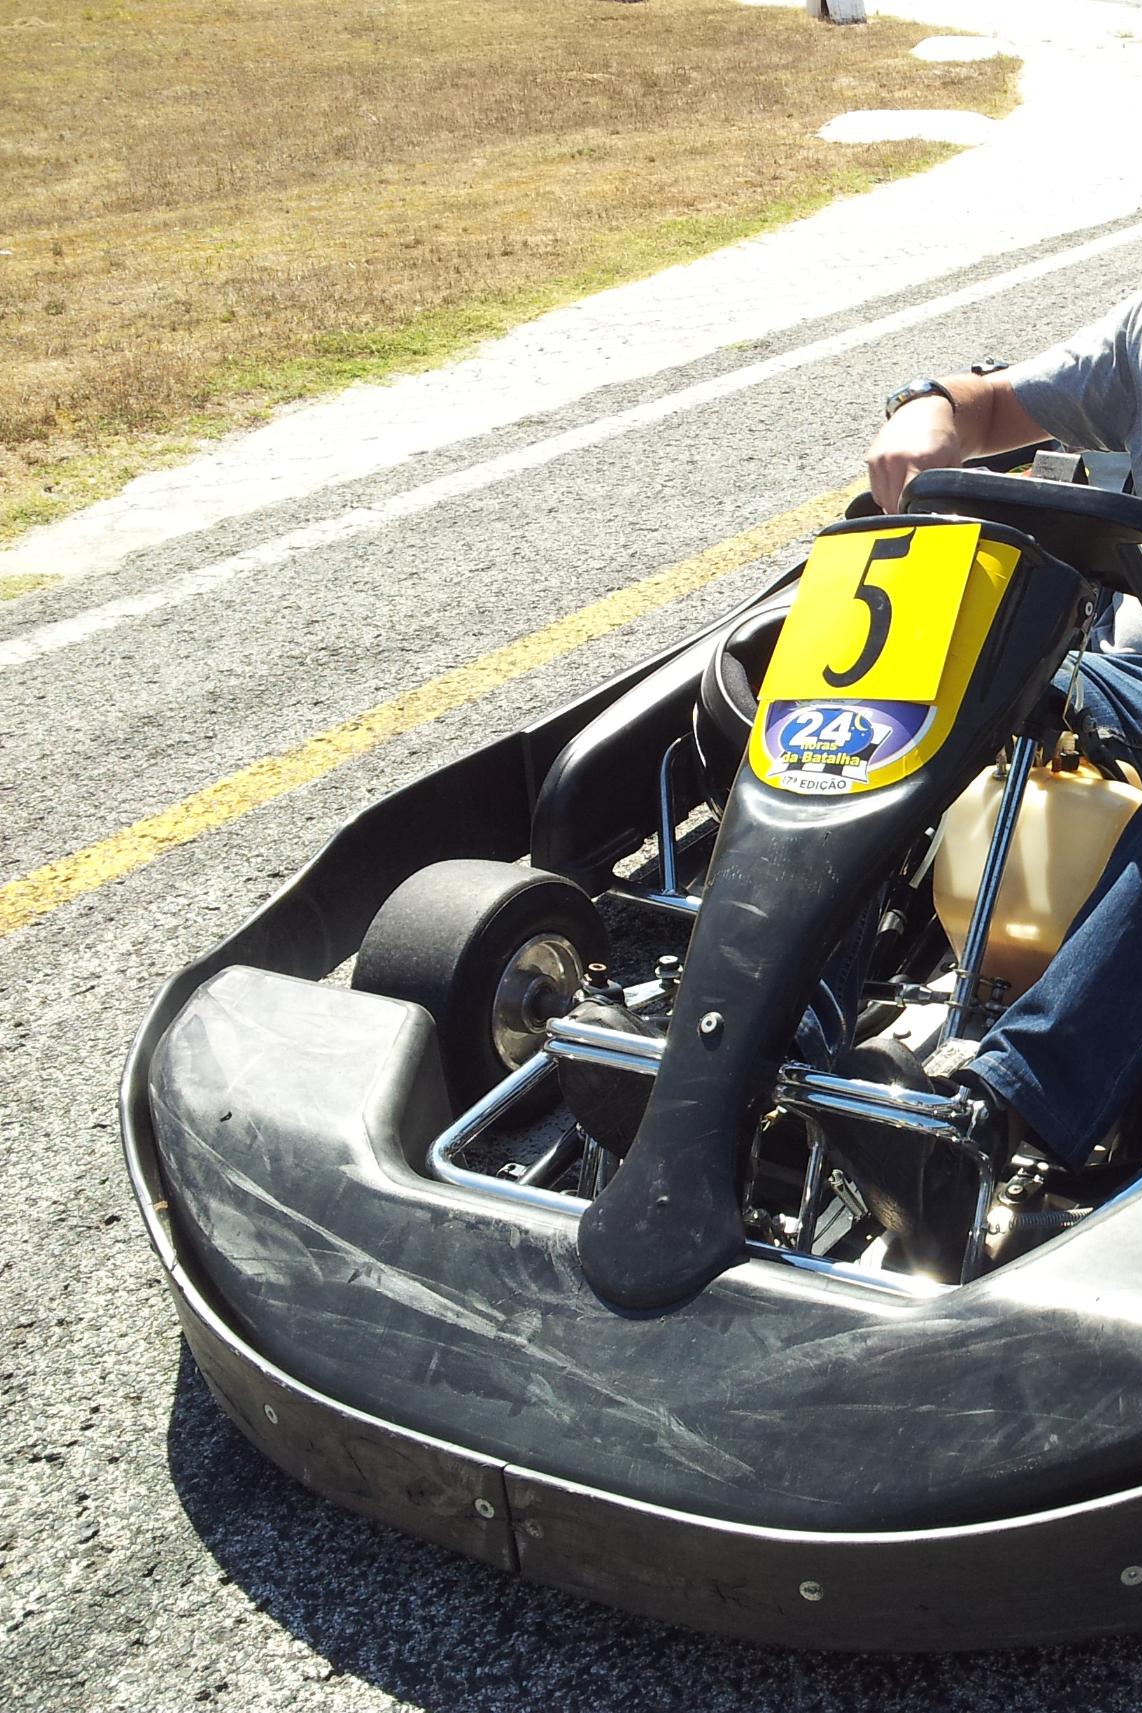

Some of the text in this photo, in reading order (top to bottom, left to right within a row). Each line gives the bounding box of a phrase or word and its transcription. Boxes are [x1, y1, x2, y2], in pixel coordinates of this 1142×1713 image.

[822, 526, 917, 688] 5
[788, 710, 854, 747] 24
[783, 751, 861, 766] da Batalha
[799, 777, 847, 791] EDIÇÃO
